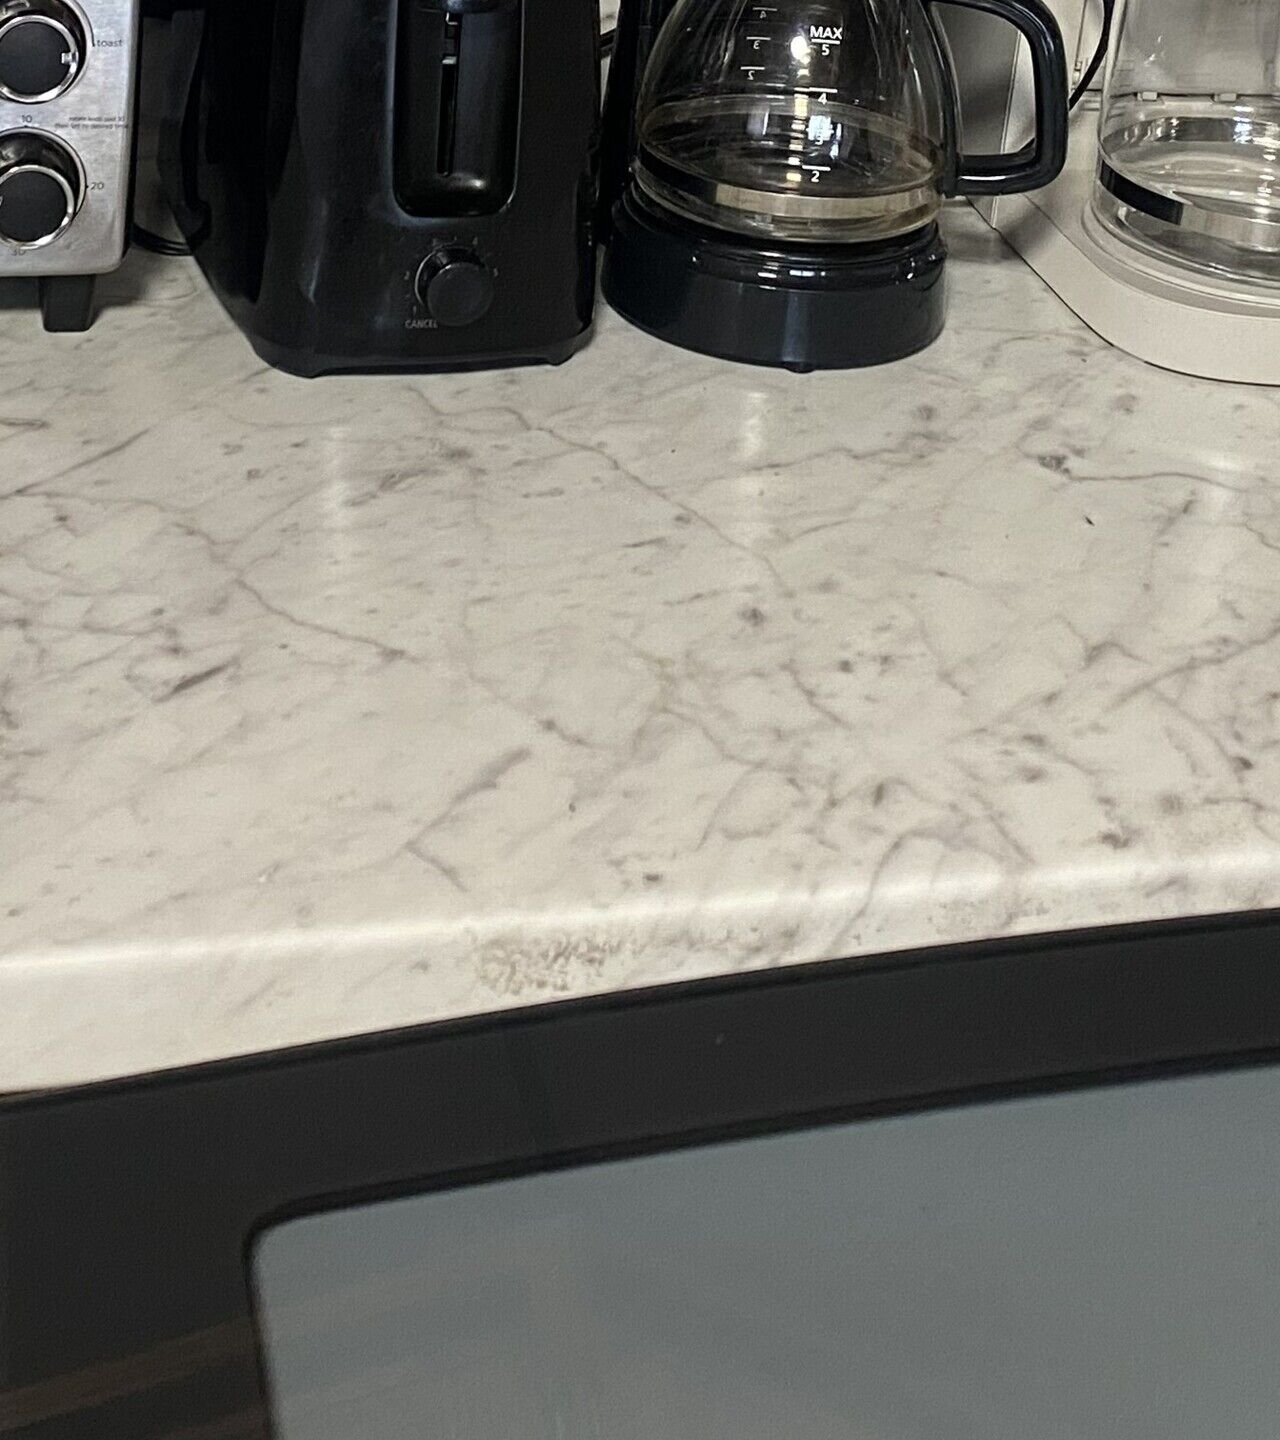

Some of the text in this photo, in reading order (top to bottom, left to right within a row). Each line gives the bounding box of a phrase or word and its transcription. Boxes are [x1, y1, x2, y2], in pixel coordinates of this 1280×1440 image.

[809, 25, 843, 40] MAX
[96, 39, 123, 48] toast
[821, 44, 830, 56] 5
[817, 93, 828, 106] 4
[21, 114, 33, 123] 10
[810, 170, 820, 183] 2
[90, 181, 105, 191] 20
[404, 319, 439, 330] CANCEL
